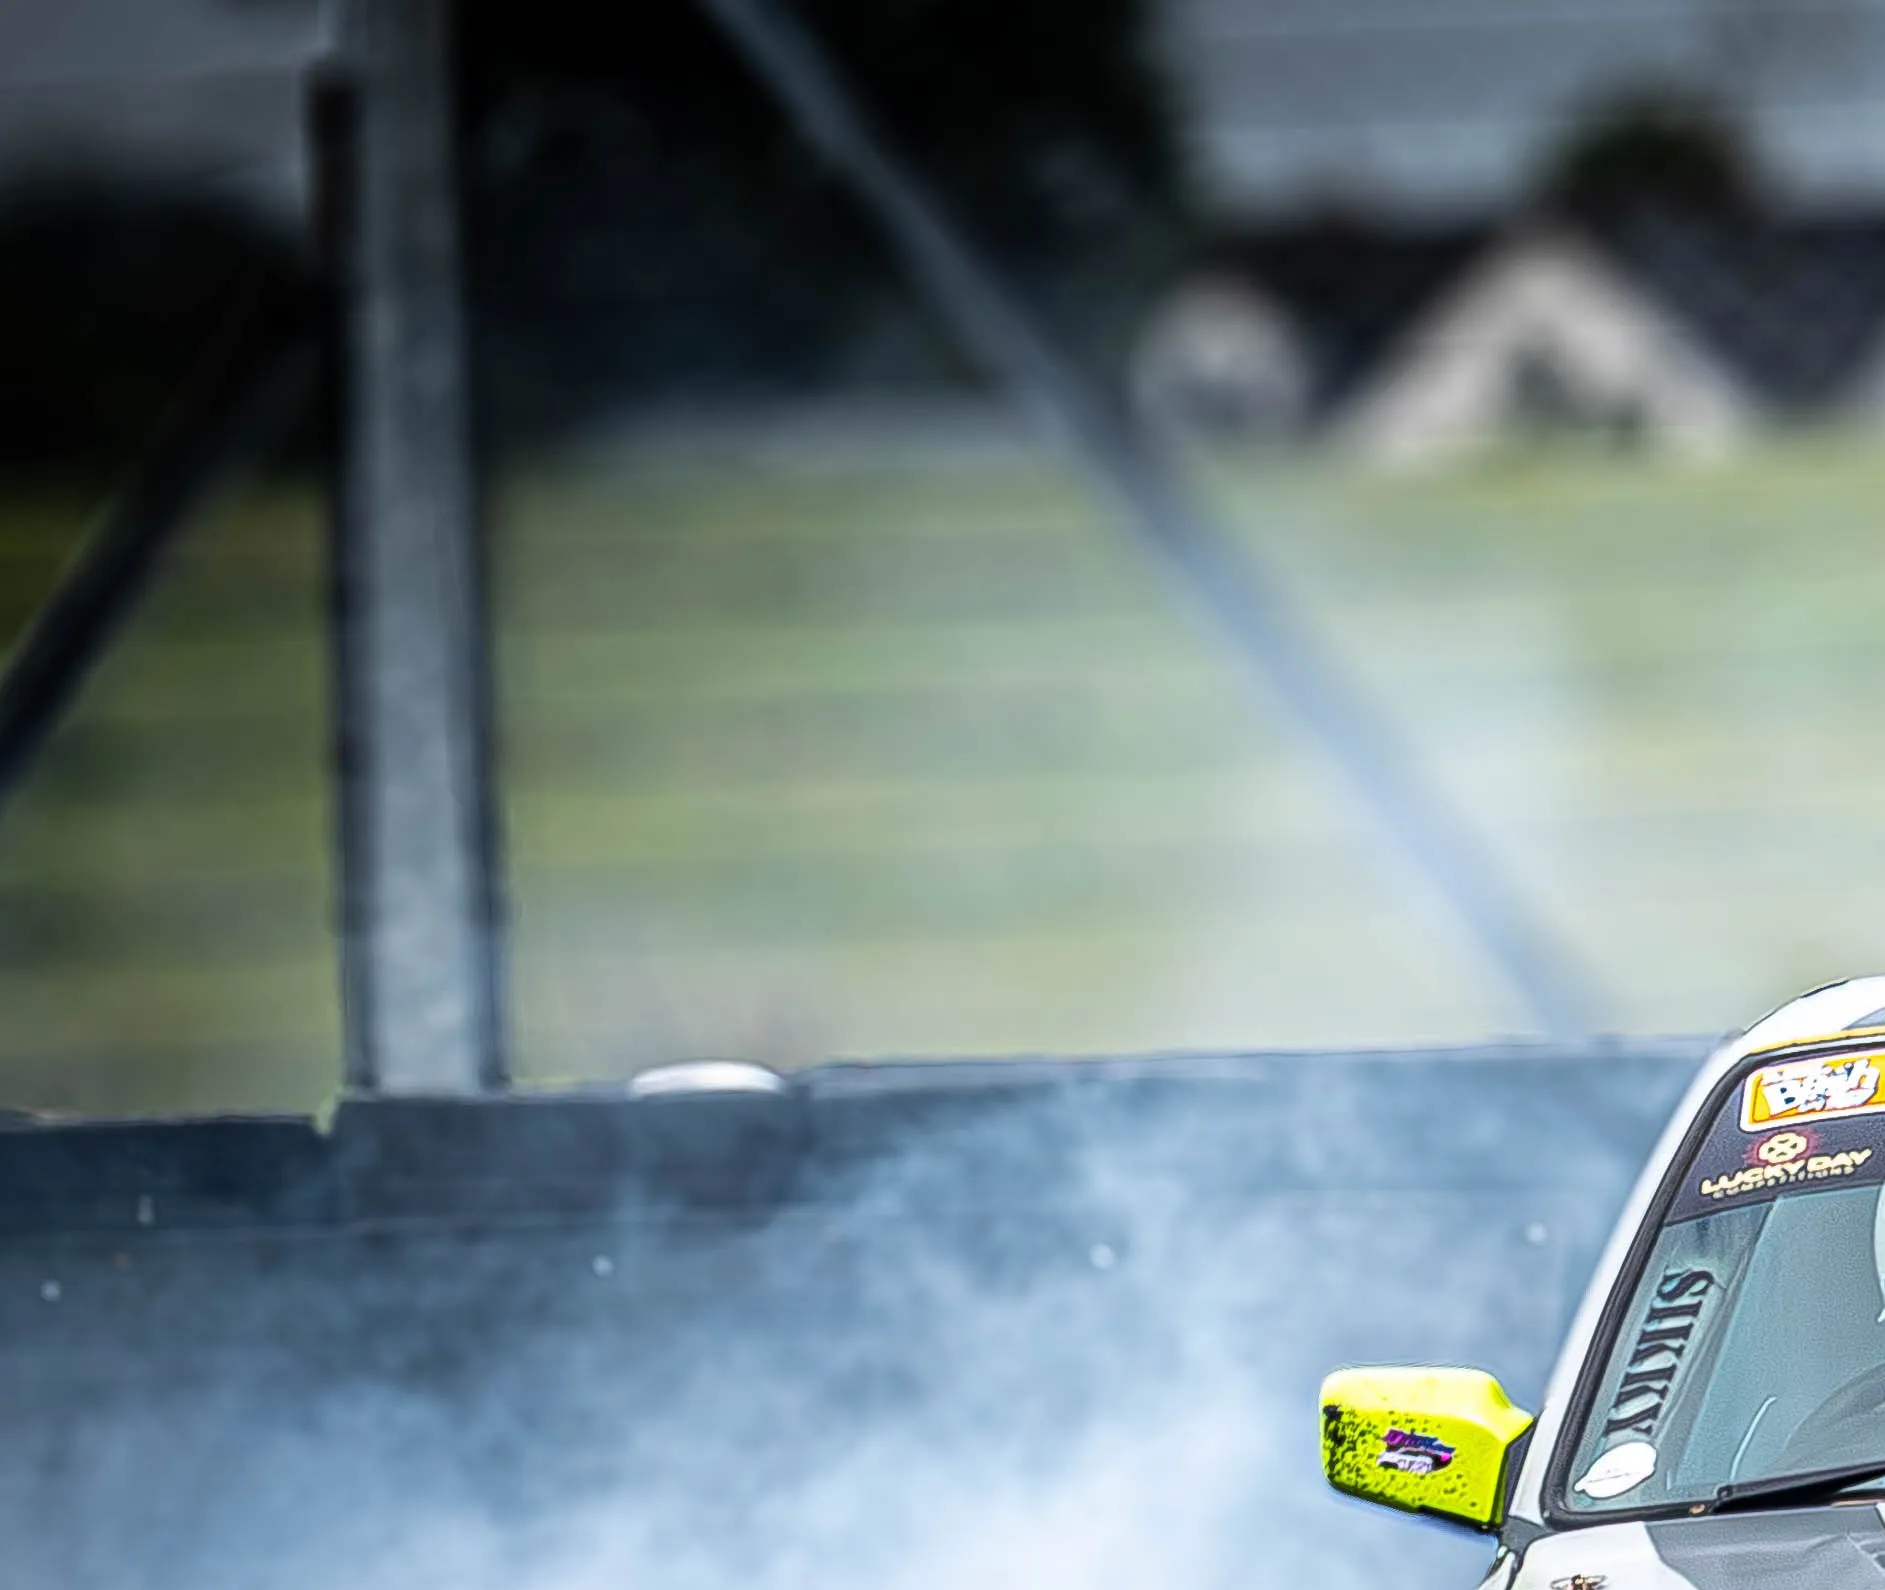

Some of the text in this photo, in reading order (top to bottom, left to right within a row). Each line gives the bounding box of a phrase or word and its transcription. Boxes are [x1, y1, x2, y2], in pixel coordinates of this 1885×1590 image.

[1700, 1148, 1872, 1195] LUCKY DAY
[1600, 1268, 1716, 1438] SIKKY
